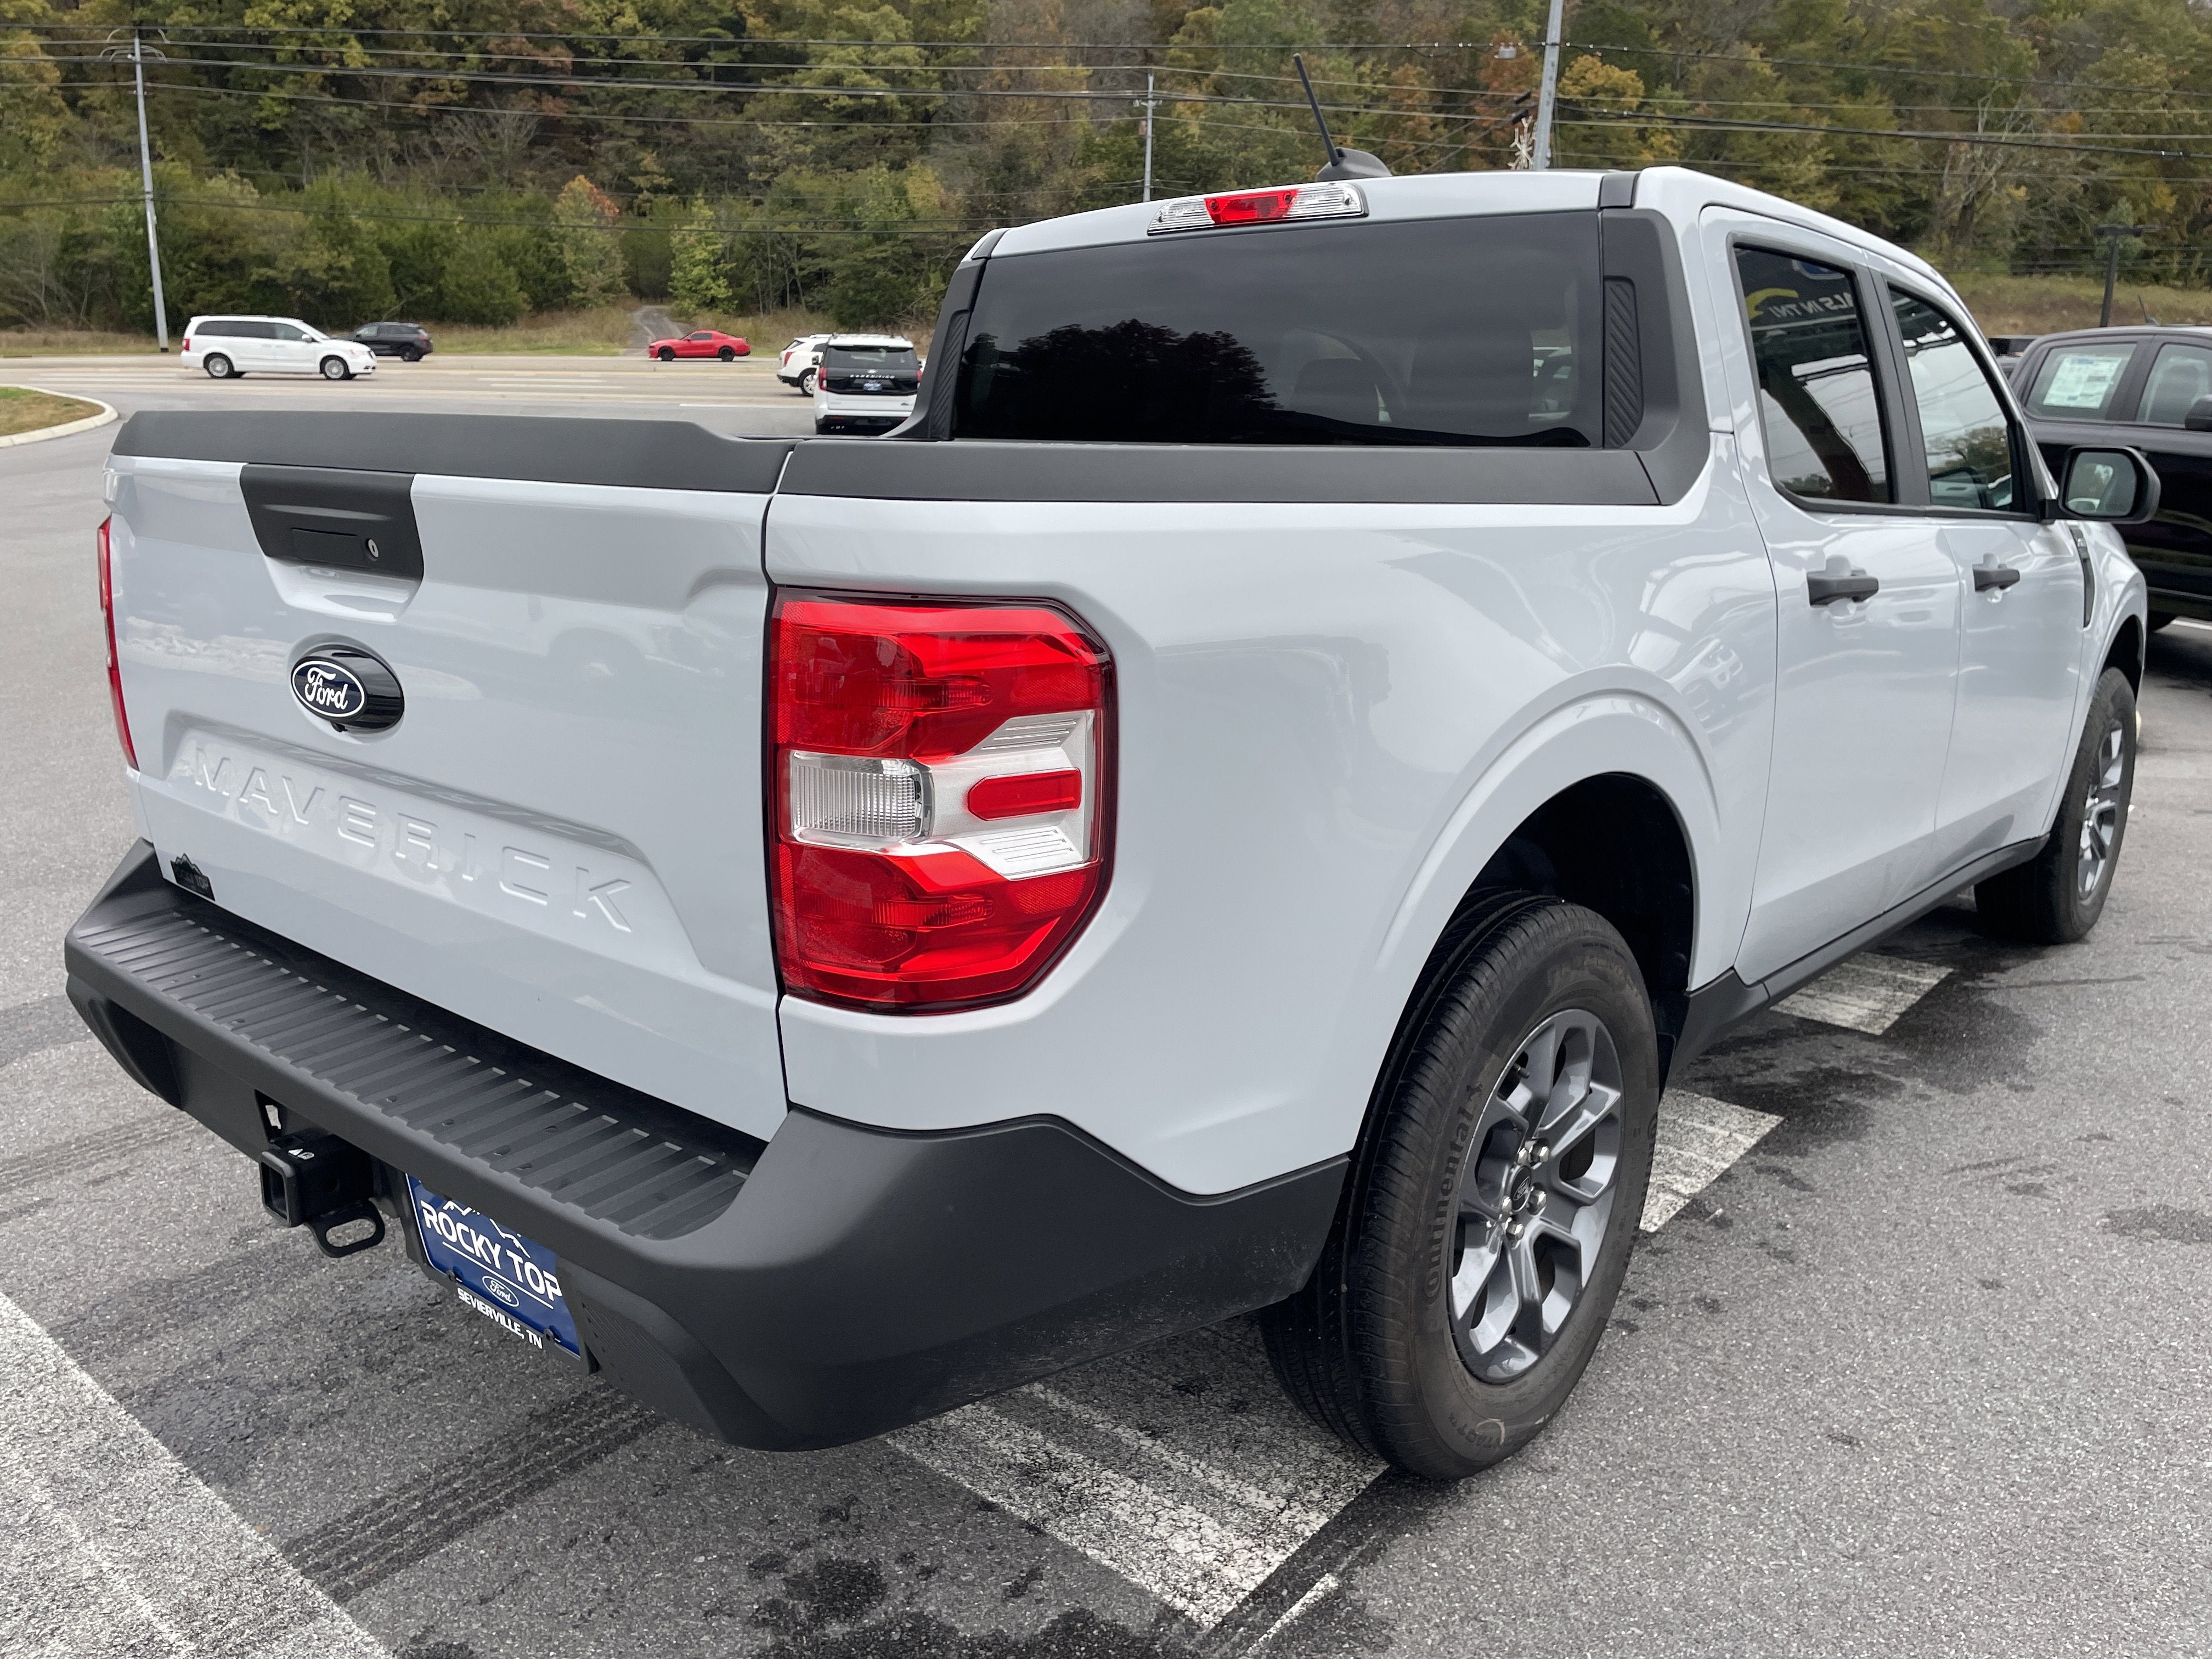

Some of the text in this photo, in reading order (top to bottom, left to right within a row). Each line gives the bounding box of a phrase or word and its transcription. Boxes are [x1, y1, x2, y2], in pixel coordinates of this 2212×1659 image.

[304, 667, 348, 710] Ford
[195, 747, 633, 932] MAVERICK
[1426, 1106, 1474, 1306] Continental
[420, 1200, 563, 1302] ROCKY TOP
[489, 1280, 512, 1303] Ford
[457, 1287, 543, 1349] SEVIERVILLE, TN
